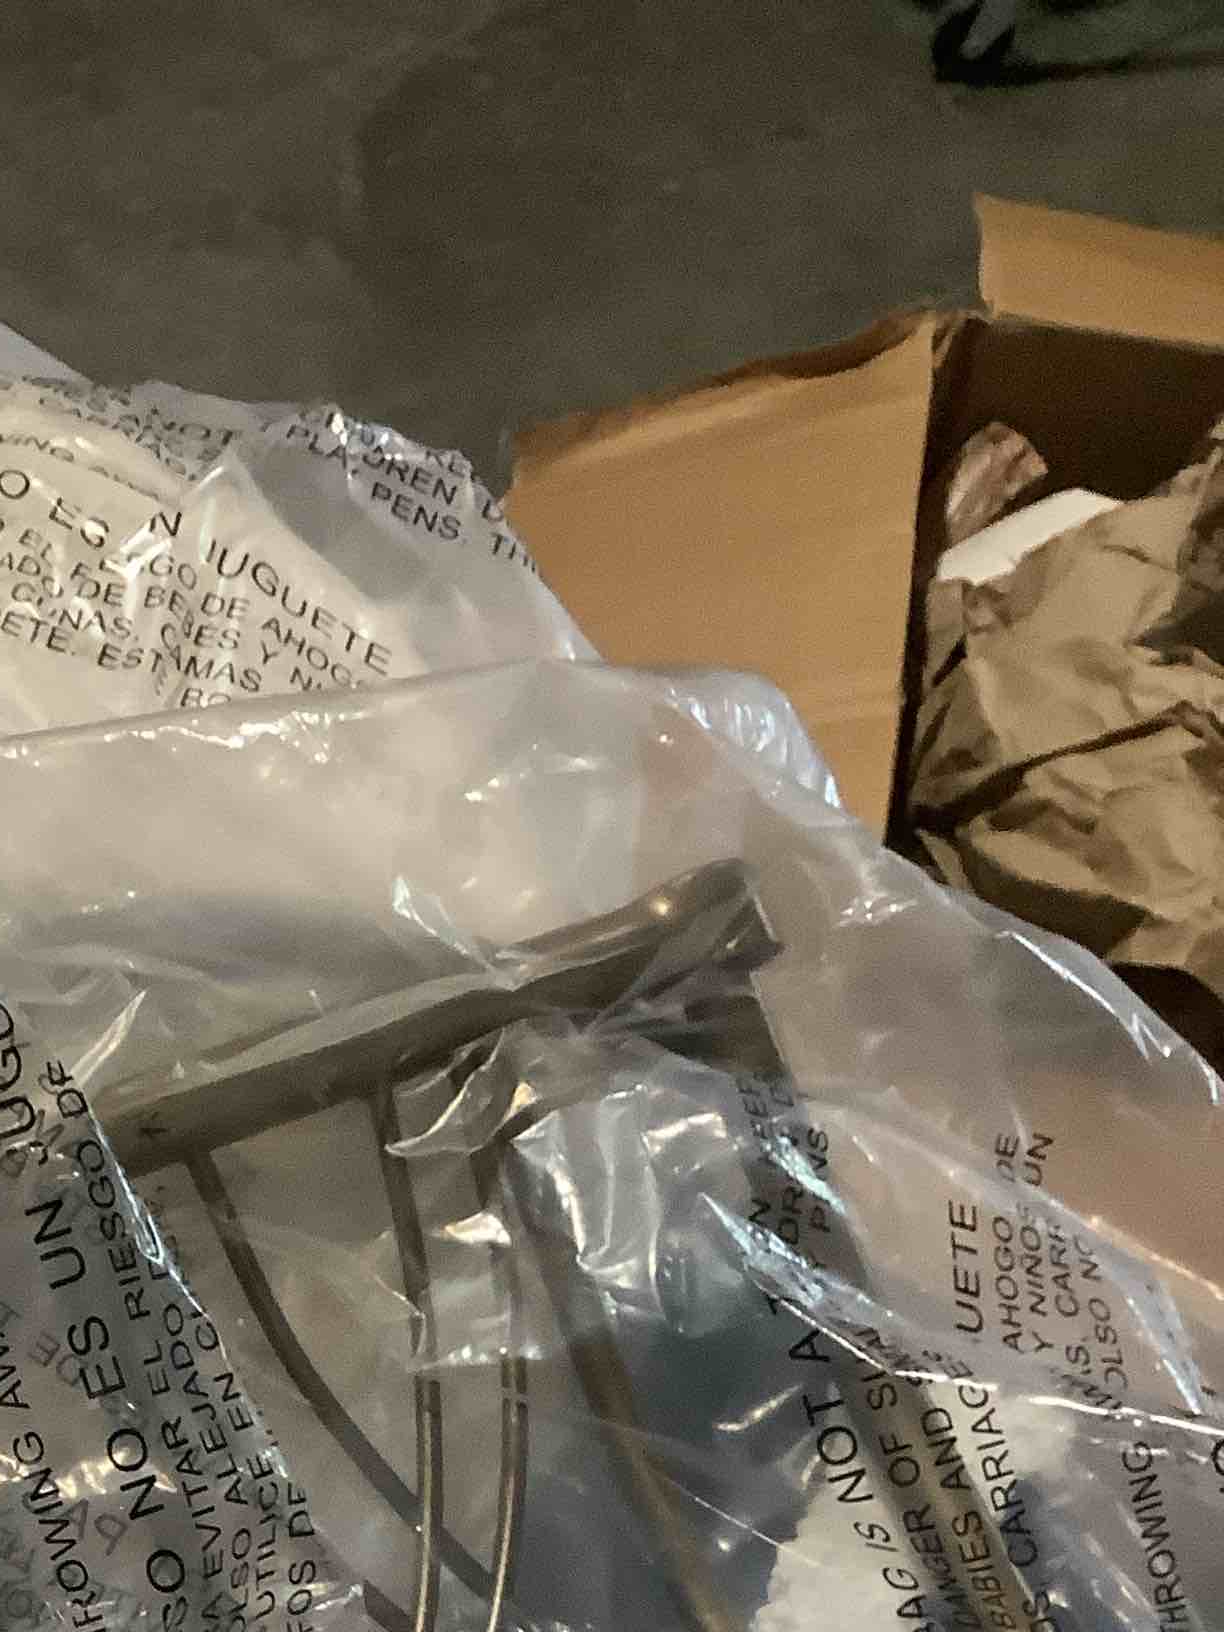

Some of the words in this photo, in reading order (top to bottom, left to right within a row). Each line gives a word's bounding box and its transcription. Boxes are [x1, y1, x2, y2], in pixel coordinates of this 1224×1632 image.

[24, 1198, 86, 1290] UN
[73, 1138, 151, 1321] RIESGO
[992, 1216, 1025, 1354] AHOGO
[67, 1315, 127, 1401] ES
[145, 1343, 171, 1395] EL
[789, 1328, 830, 1363] A
[1030, 1331, 1055, 1353] Y
[213, 1372, 253, 1431] EN
[106, 1427, 166, 1522] NO
[802, 1394, 873, 1504] NOT
[879, 1432, 921, 1488] OF
[919, 1406, 972, 1492] AND
[160, 1417, 223, 1579] EVITAR
[853, 1520, 899, 1553] IS
